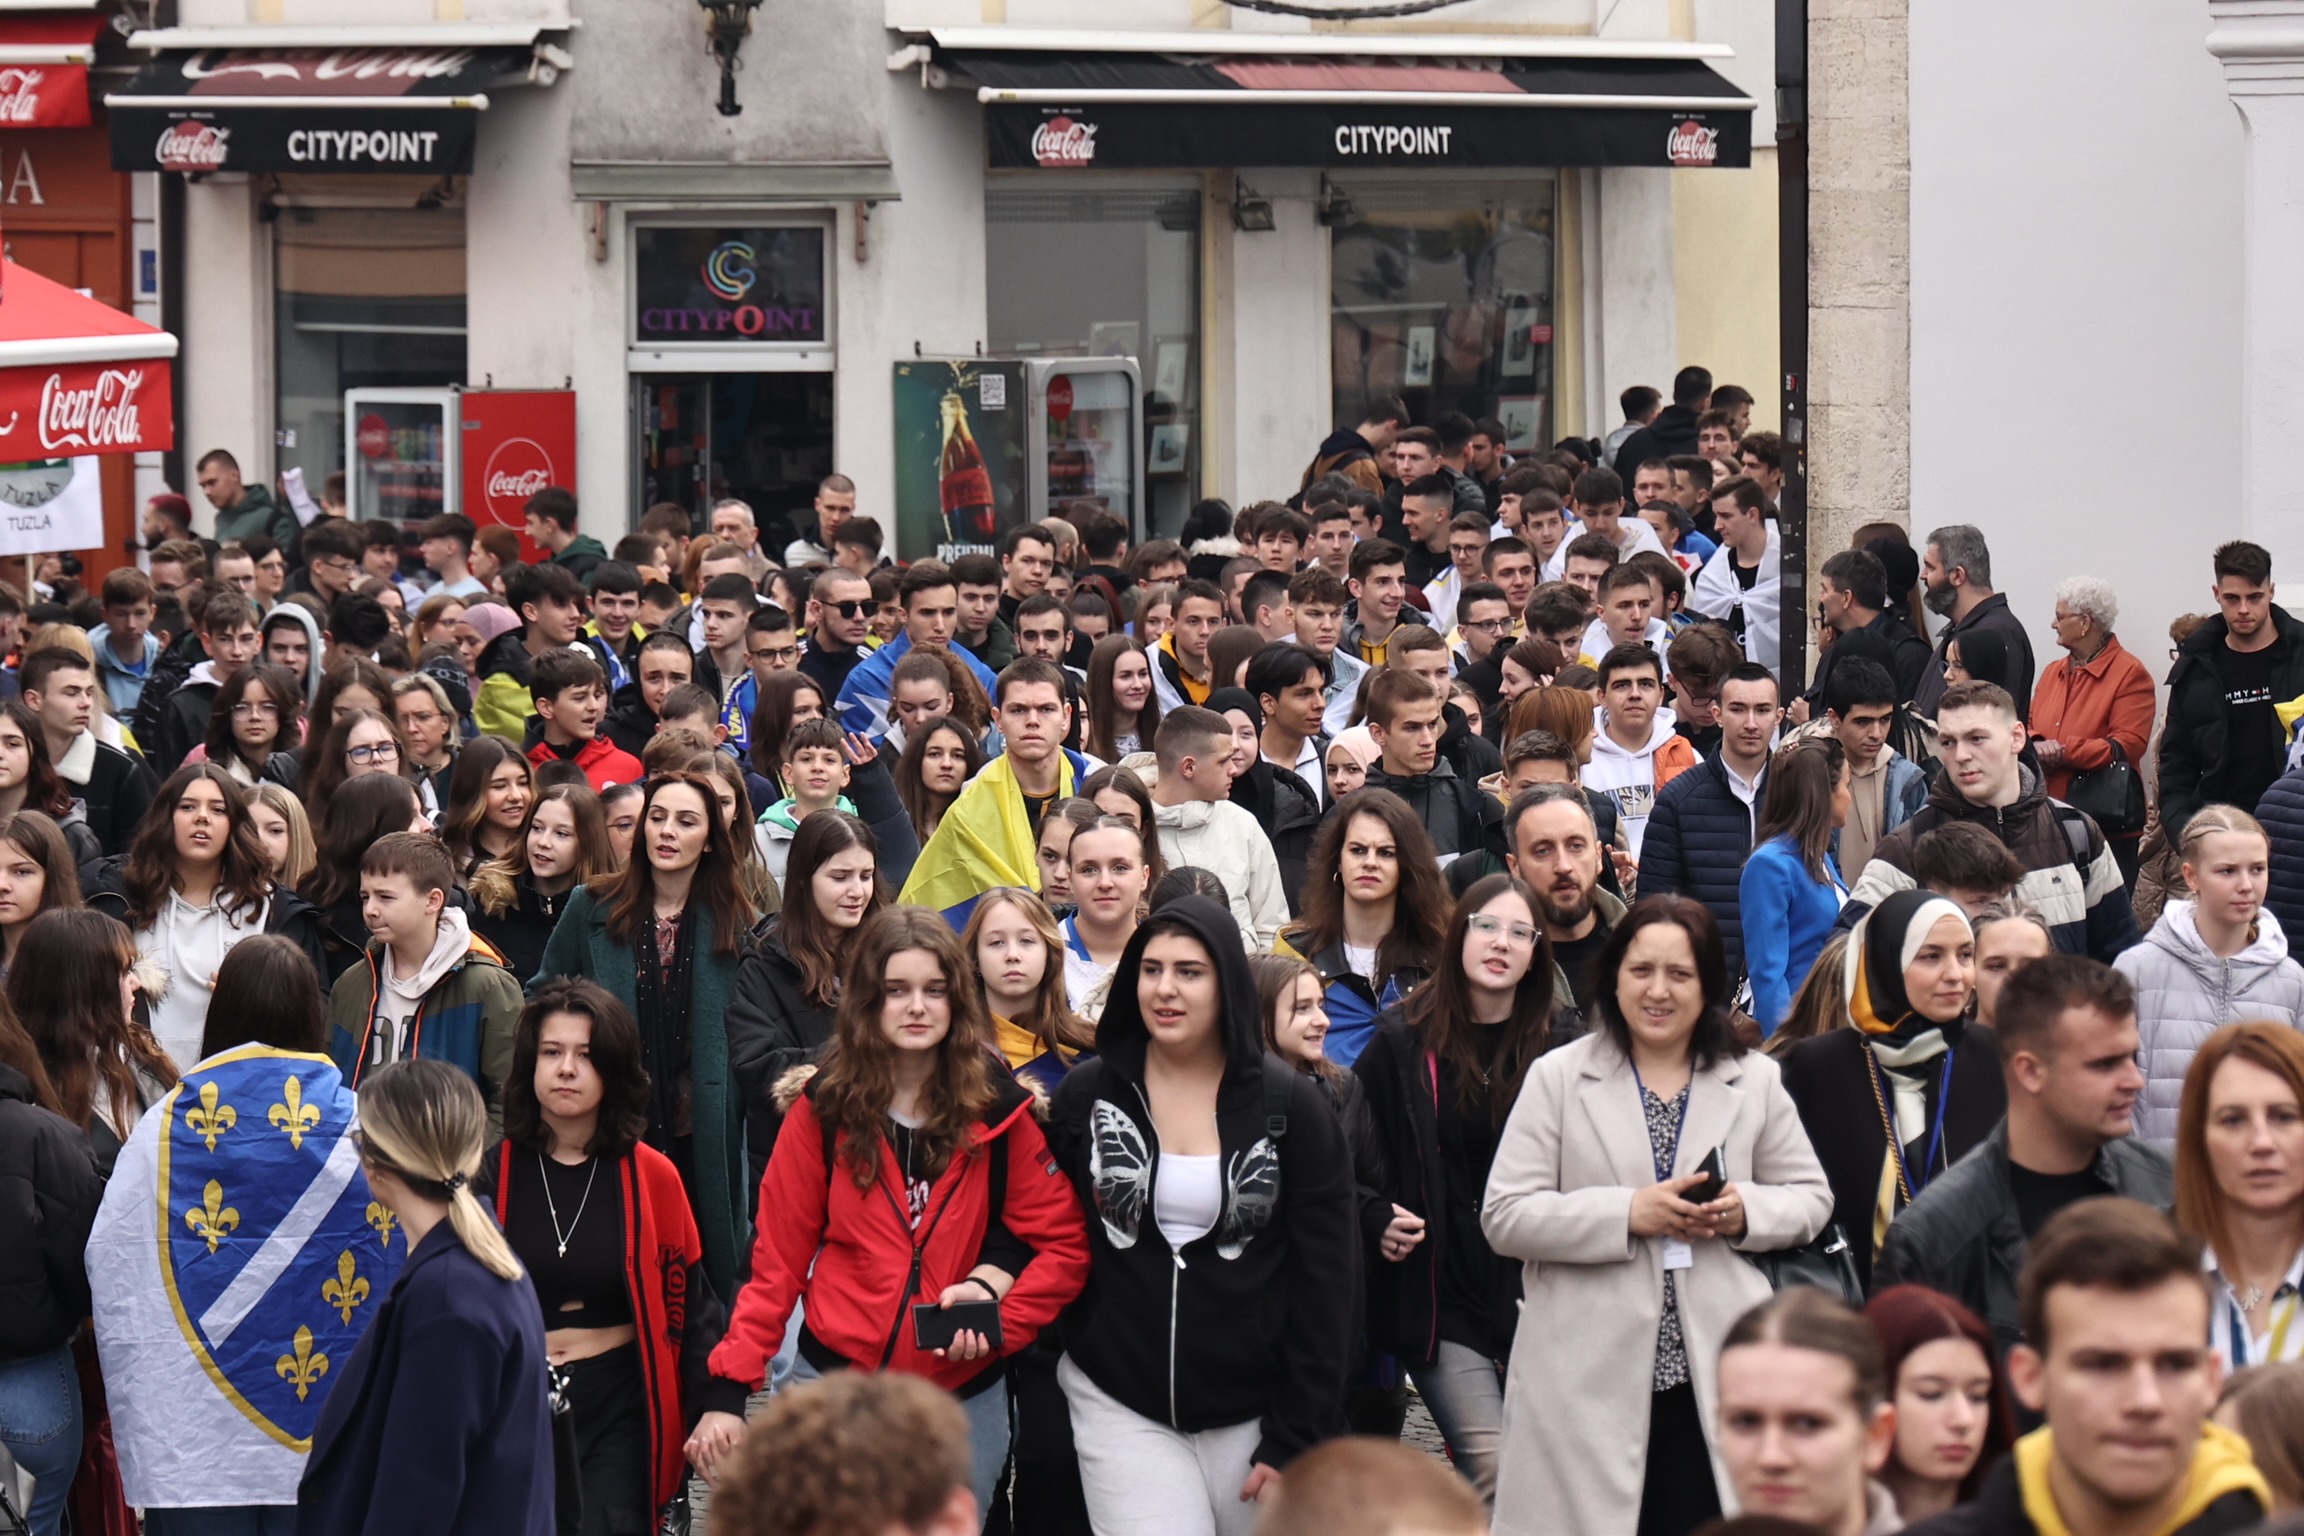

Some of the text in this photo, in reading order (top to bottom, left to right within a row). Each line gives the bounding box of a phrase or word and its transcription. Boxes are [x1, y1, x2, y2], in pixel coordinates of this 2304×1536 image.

[287, 130, 439, 162] CITYPOINT
[1335, 125, 1452, 155] CITYPOINT
[642, 305, 817, 335] CITYPOINT
[38, 369, 144, 450] Coca-Cola
[7, 515, 52, 531] TUZLA
